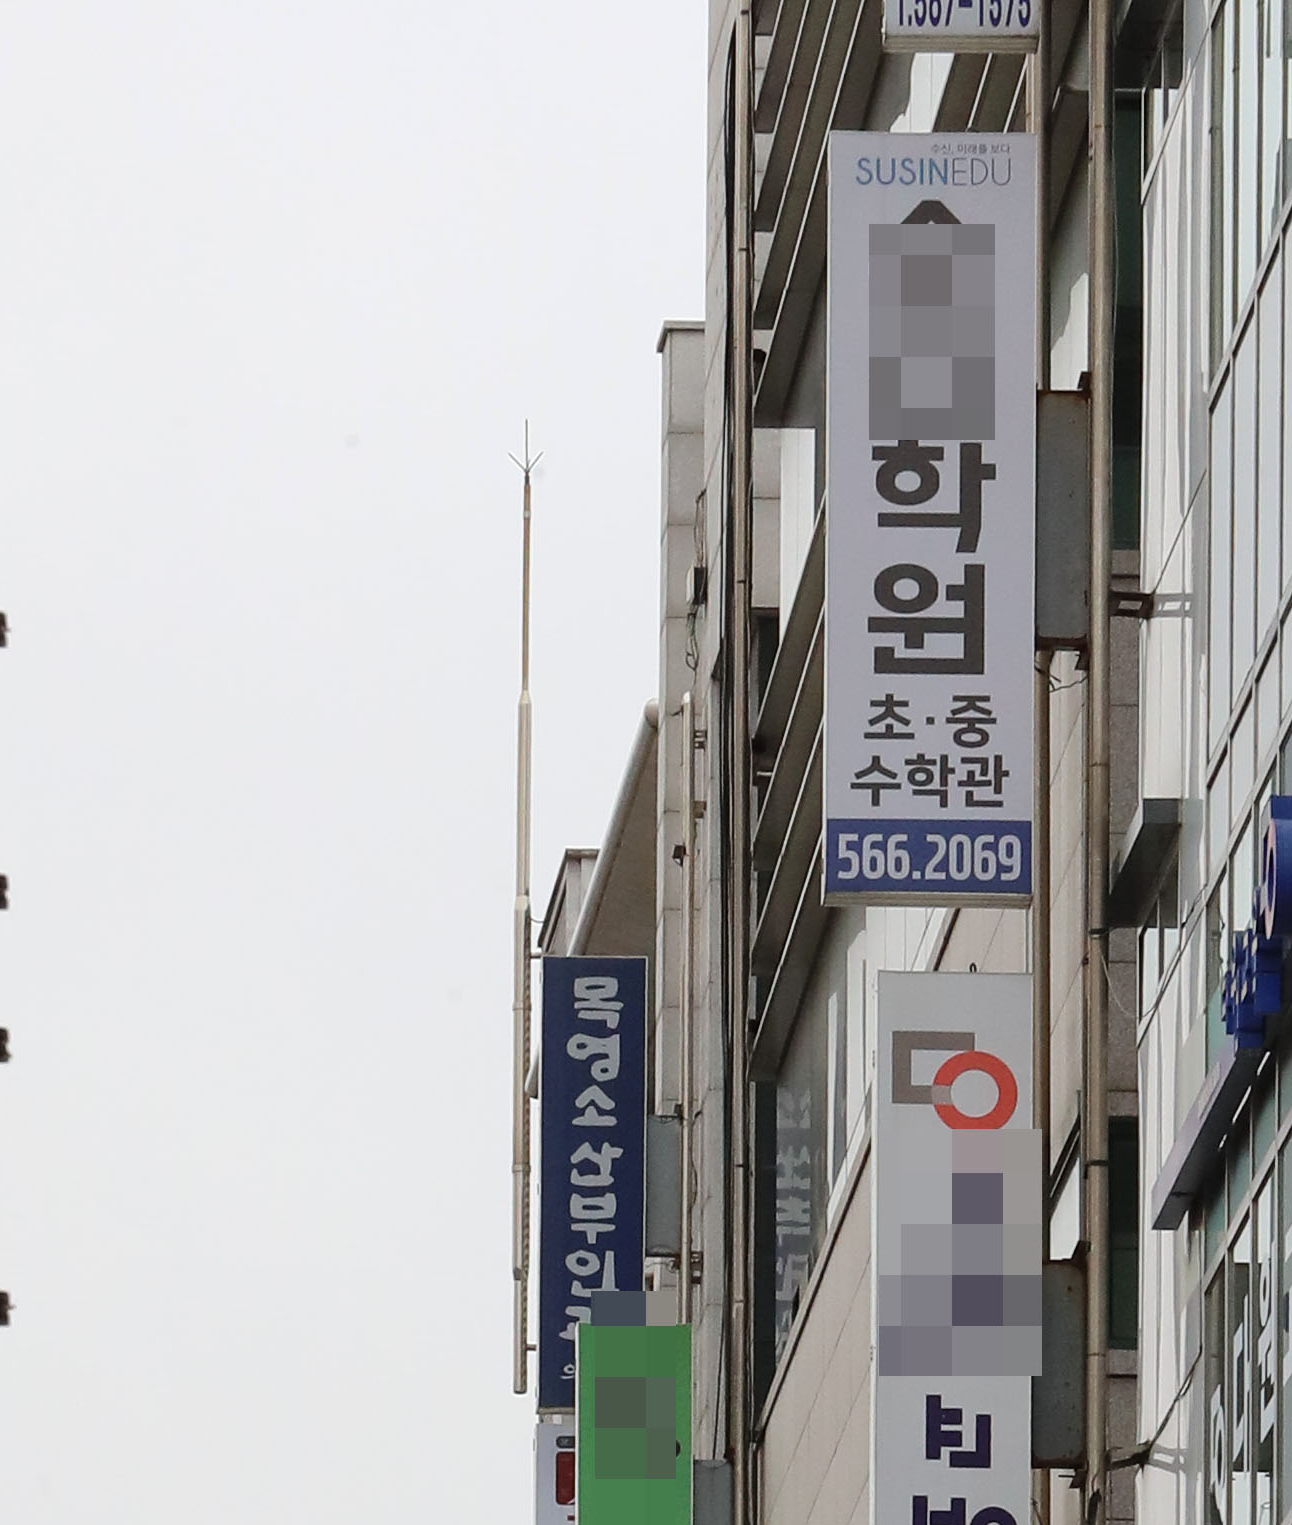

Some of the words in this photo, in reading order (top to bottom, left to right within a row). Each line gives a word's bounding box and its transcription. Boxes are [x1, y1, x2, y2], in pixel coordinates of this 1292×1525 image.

[855, 157, 1012, 187] SUSINEDU
[867, 440, 997, 676] 학원
[849, 752, 1010, 809] 수학관
[836, 832, 1023, 886] 566.2069
